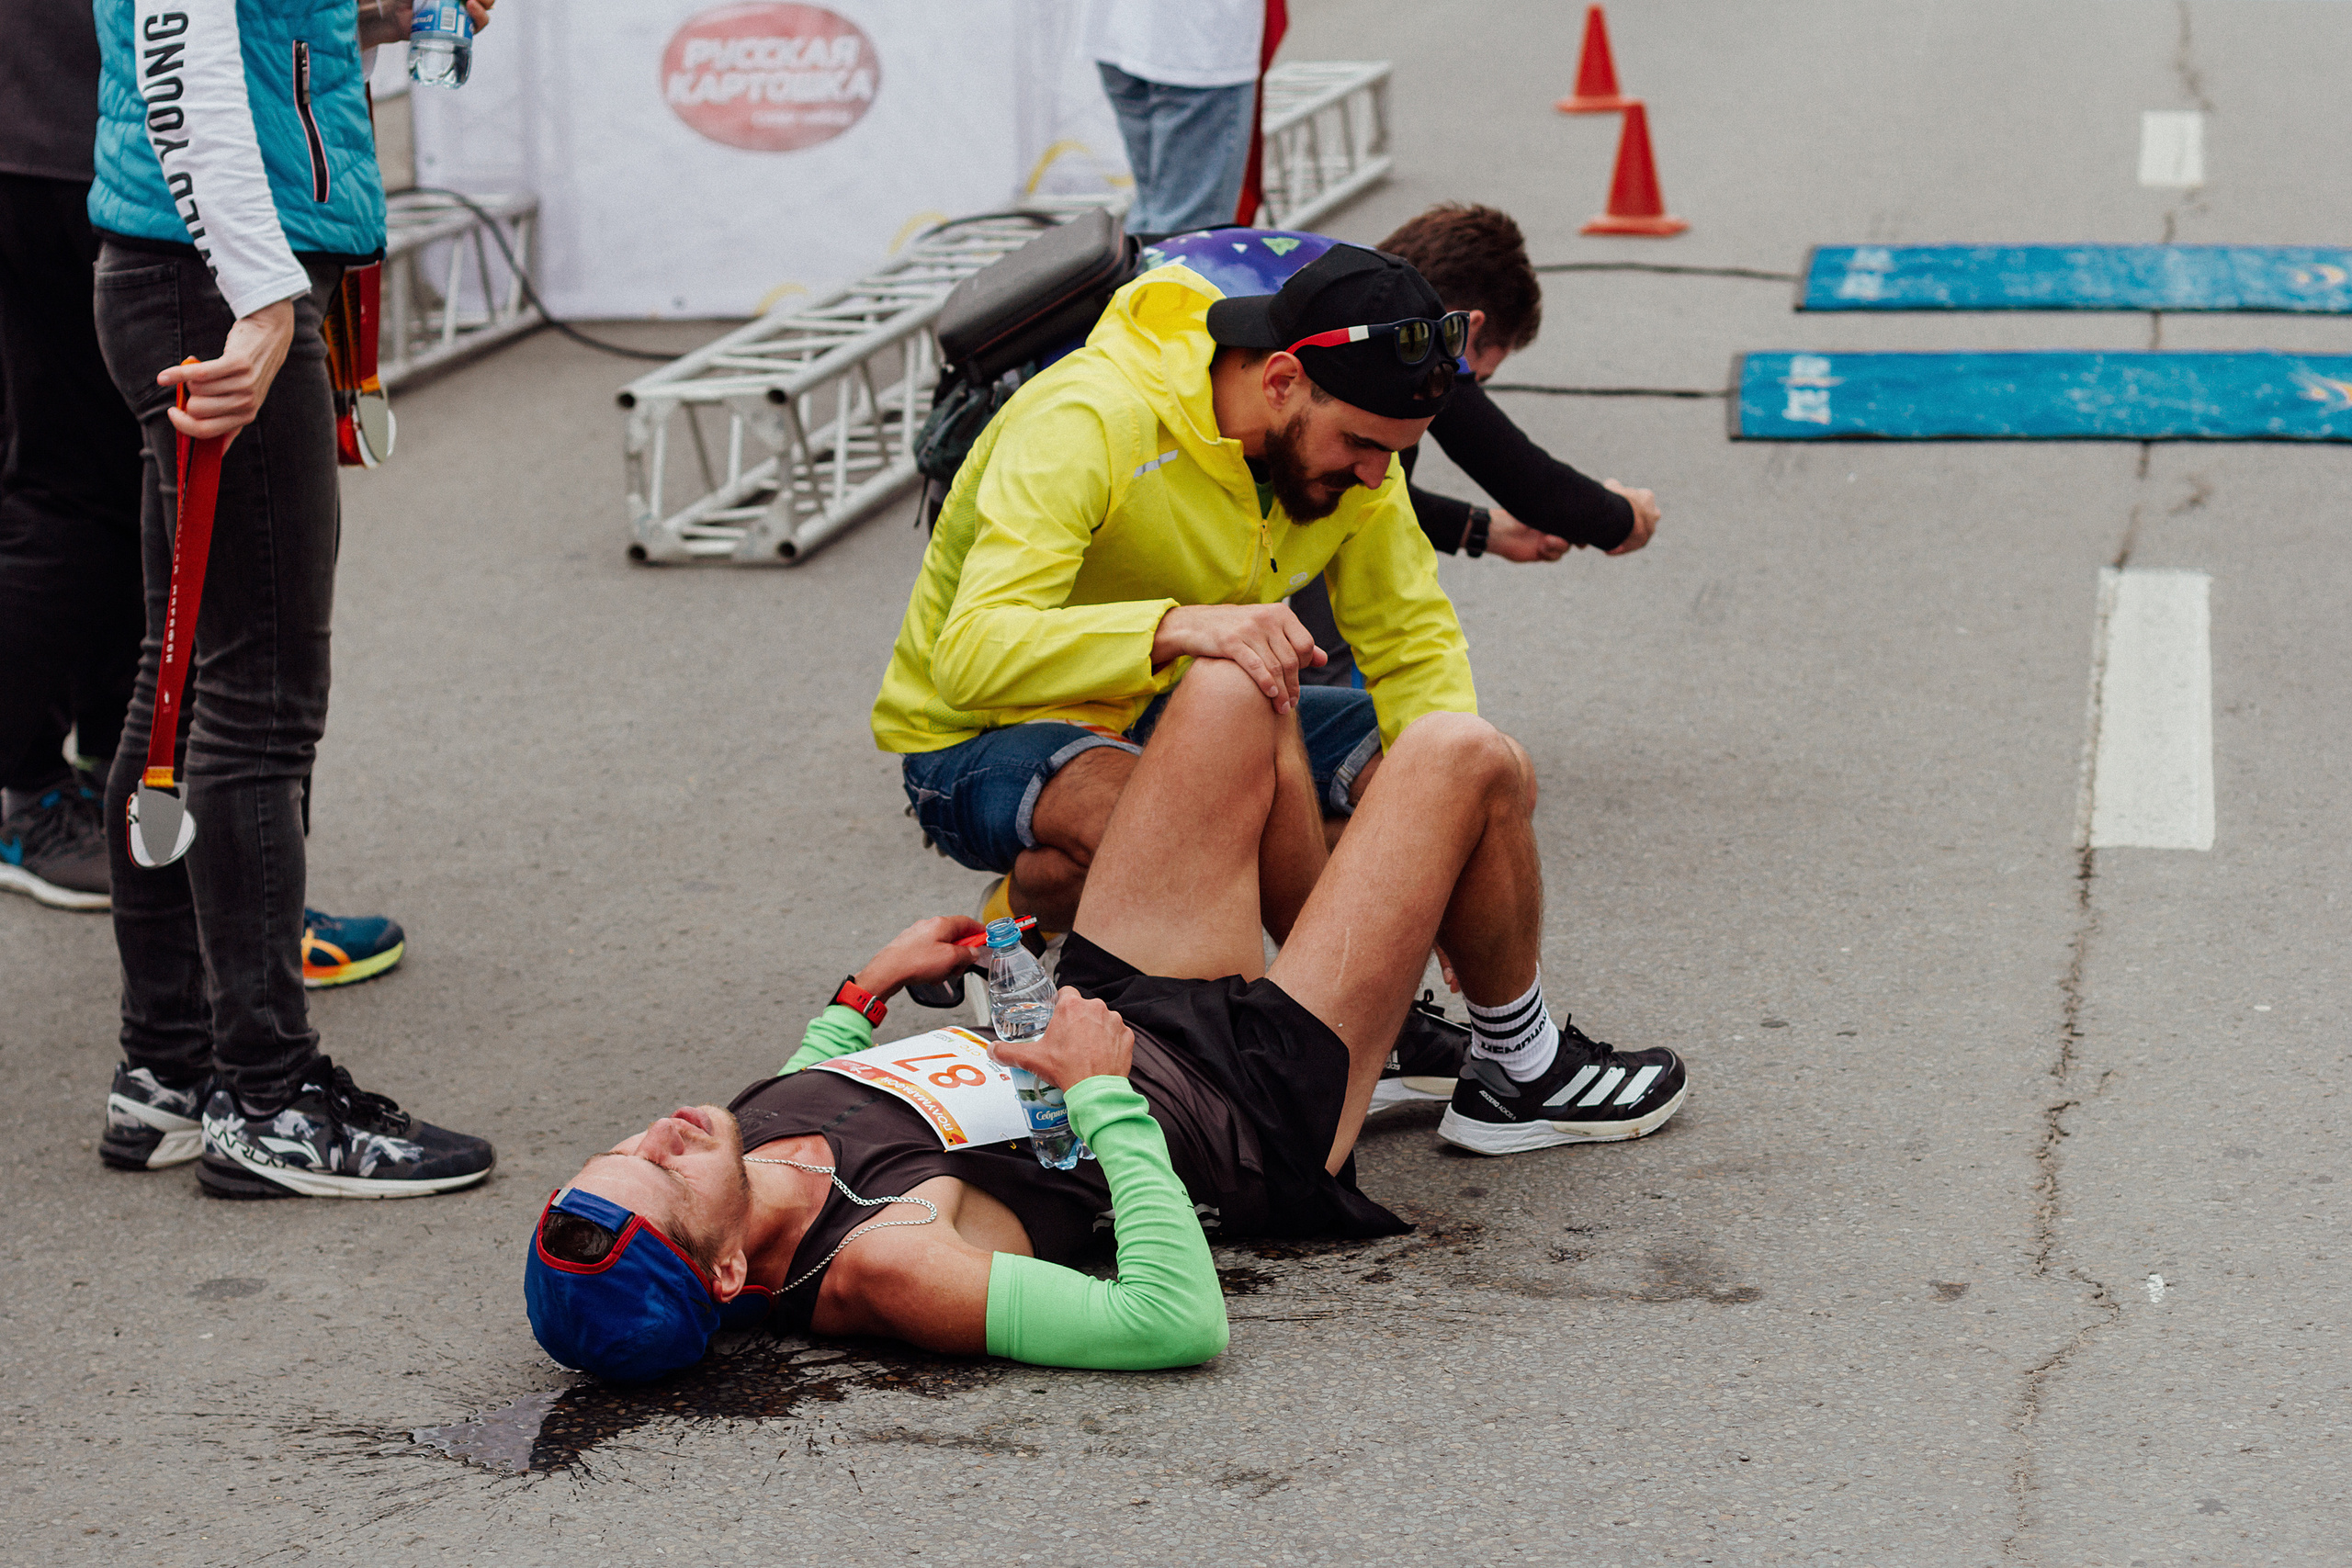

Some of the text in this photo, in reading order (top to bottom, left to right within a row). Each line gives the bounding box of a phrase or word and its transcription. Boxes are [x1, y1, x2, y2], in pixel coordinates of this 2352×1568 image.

[142, 11, 189, 164] YOUNG
[891, 1053, 986, 1089] 87
[880, 1077, 954, 1132] ПОЛУМАРАФОН
